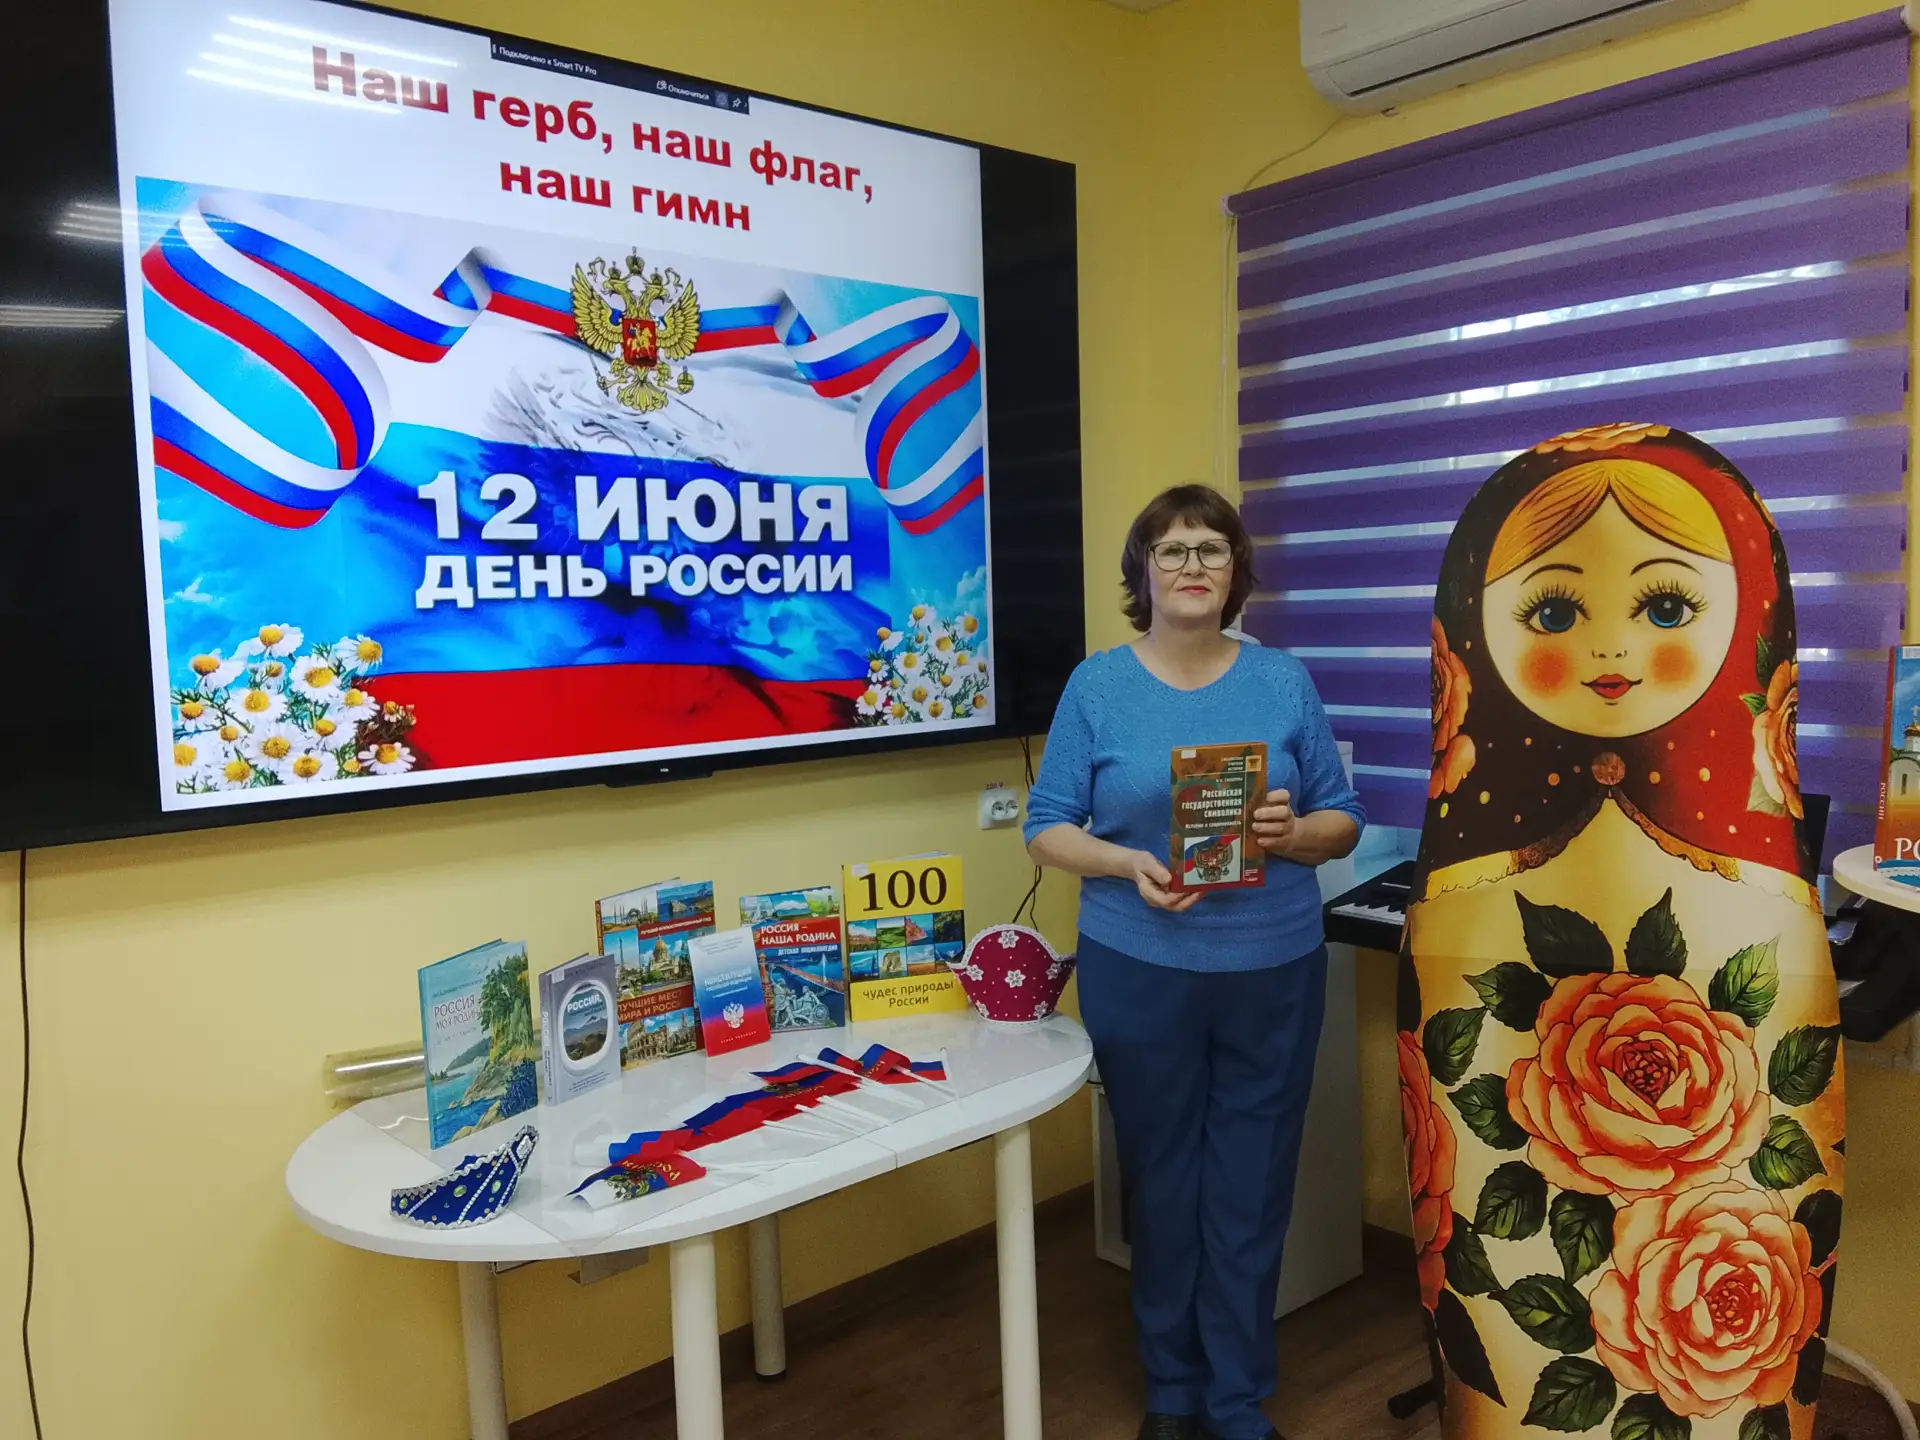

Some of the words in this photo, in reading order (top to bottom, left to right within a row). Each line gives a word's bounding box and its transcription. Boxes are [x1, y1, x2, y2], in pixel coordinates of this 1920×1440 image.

[499, 46, 546, 65] Подключено
[553, 58, 573, 71] Smart
[575, 62, 584, 73] TV
[585, 65, 597, 76] Pro
[312, 46, 449, 114] Наш
[472, 89, 613, 155] герб,
[632, 122, 732, 168] наш
[749, 140, 873, 204] флаг,
[500, 161, 611, 208] наш
[632, 184, 750, 231] гимн
[417, 470, 539, 541] 12
[575, 474, 849, 543] ИЮНЯ
[415, 554, 608, 609] ДЕНЬ
[629, 553, 853, 597] РОССИИ
[1202, 788, 1242, 799] Российская
[1181, 798, 1242, 810] государственная
[1204, 808, 1242, 818] символика
[859, 867, 948, 912] 100
[761, 923, 799, 935] РОССИЯ
[762, 935, 794, 945] НАША
[795, 932, 837, 943] РОДИНА
[778, 947, 799, 956] ДЕТСКАЯ
[863, 985, 898, 999] чудес
[901, 981, 954, 996] природы
[434, 994, 475, 1019] РОССИЯ
[889, 996, 929, 1008] России
[643, 1007, 651, 1016] И
[436, 1017, 452, 1031] МОЯ
